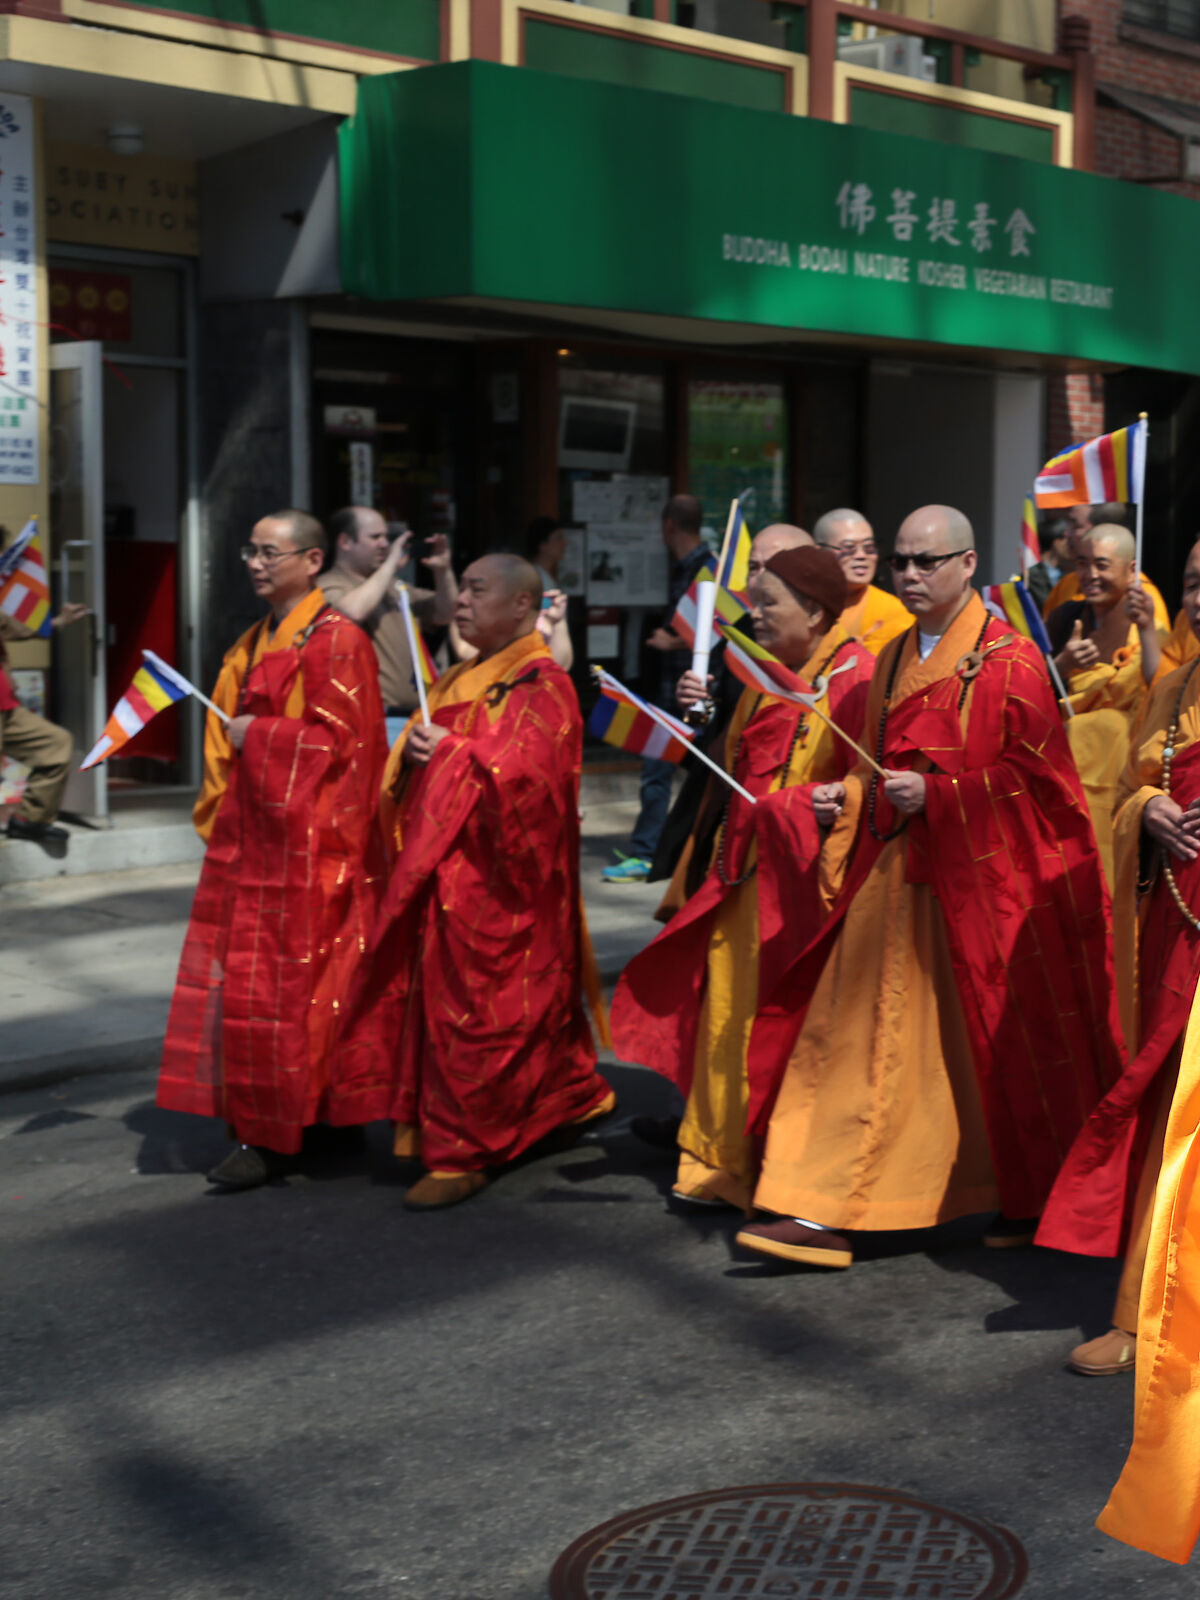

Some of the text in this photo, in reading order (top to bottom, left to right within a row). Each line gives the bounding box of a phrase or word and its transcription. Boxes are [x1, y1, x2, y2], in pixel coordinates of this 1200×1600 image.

[835, 181, 1036, 257] 佛菩提素食
[722, 233, 1114, 310] BUDDHA BODAI NATURE KOSHER VEGETARIAN RESTAURANT
[776, 1504, 836, 1566] SEWER
